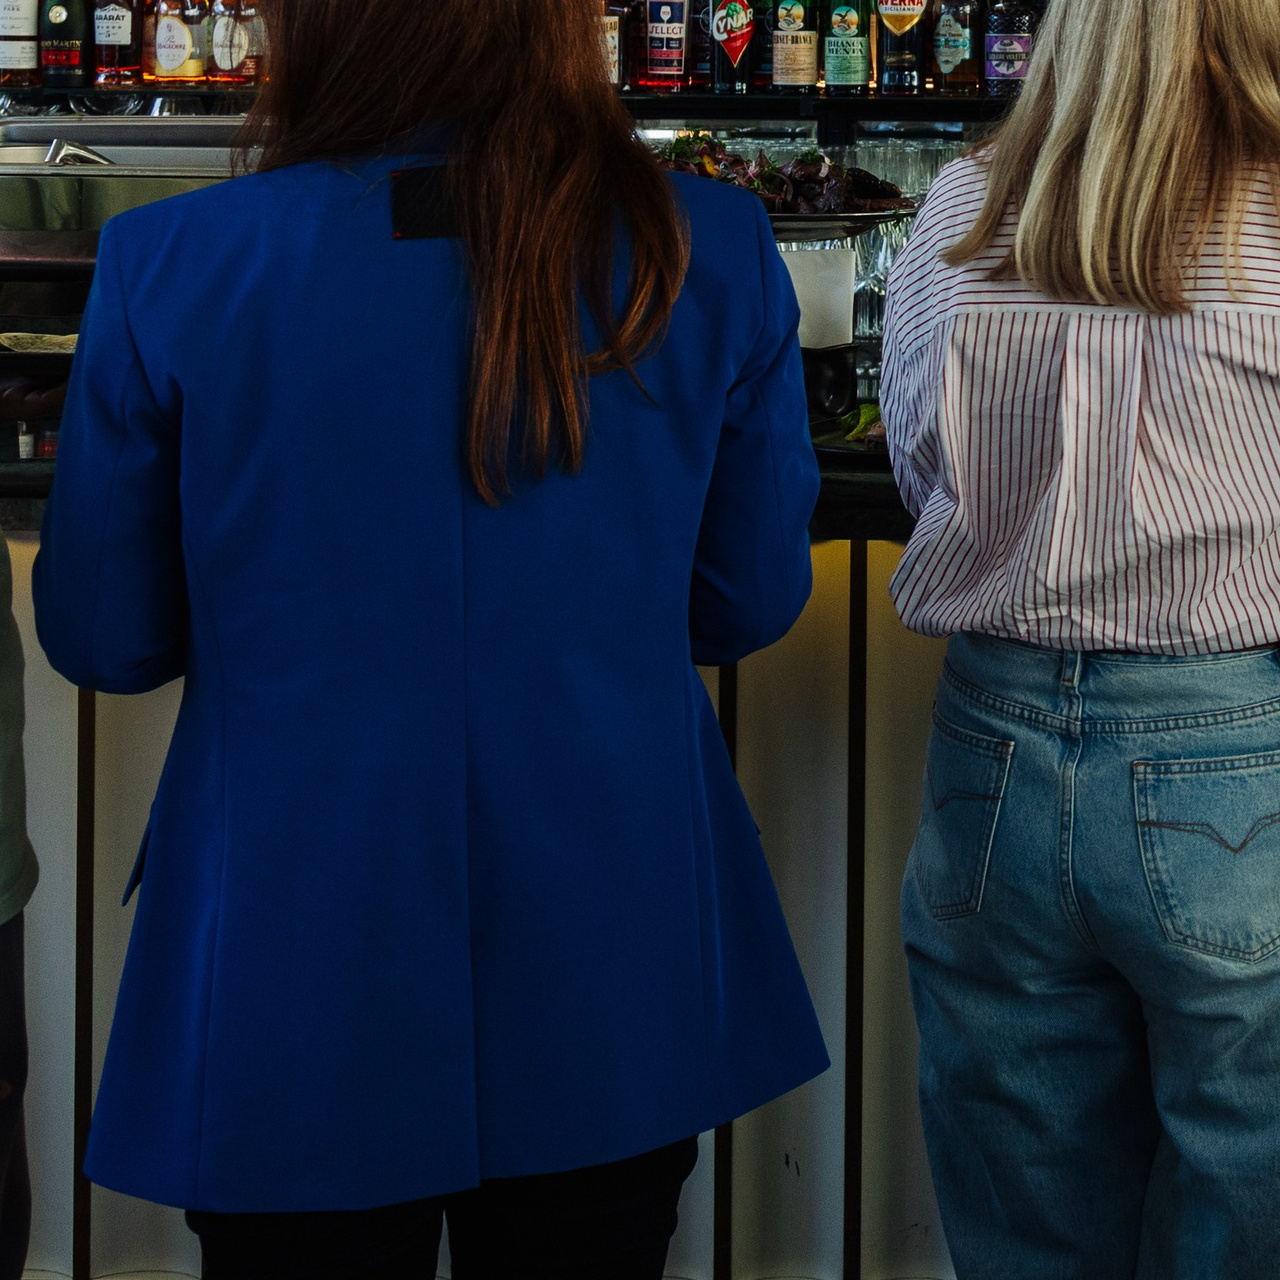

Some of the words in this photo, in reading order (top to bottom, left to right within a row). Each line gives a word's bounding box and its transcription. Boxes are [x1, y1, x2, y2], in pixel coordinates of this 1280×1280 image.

[712, 8, 753, 42] CYNAR
[105, 30, 111, 38] 5
[650, 25, 683, 35] SELECT
[773, 34, 812, 45] ERNET-BRANCA
[827, 40, 864, 48] BRANCA
[827, 47, 864, 55] MENTA
